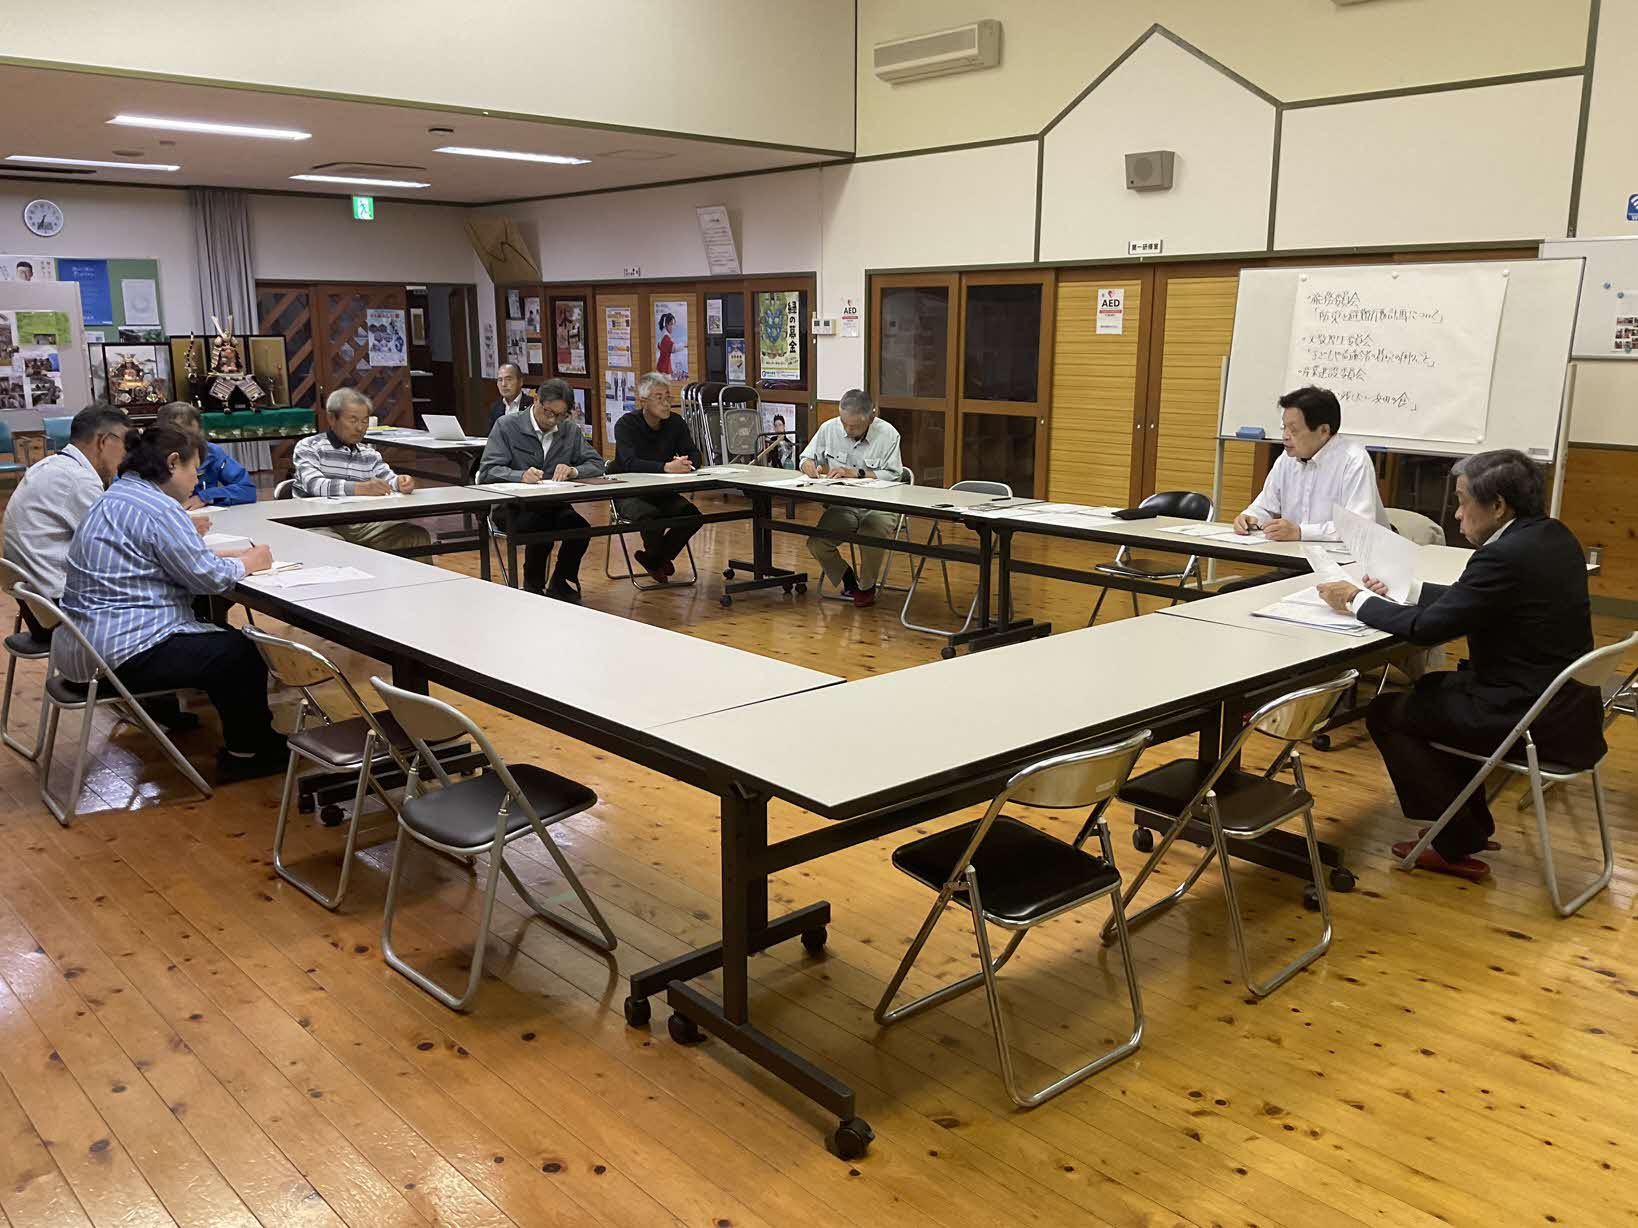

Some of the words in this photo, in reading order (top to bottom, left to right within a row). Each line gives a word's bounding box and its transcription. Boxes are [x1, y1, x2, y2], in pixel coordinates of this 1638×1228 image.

[1101, 299, 1120, 308] AED
[843, 307, 857, 315] AED
[787, 301, 798, 354] 緑の募金
